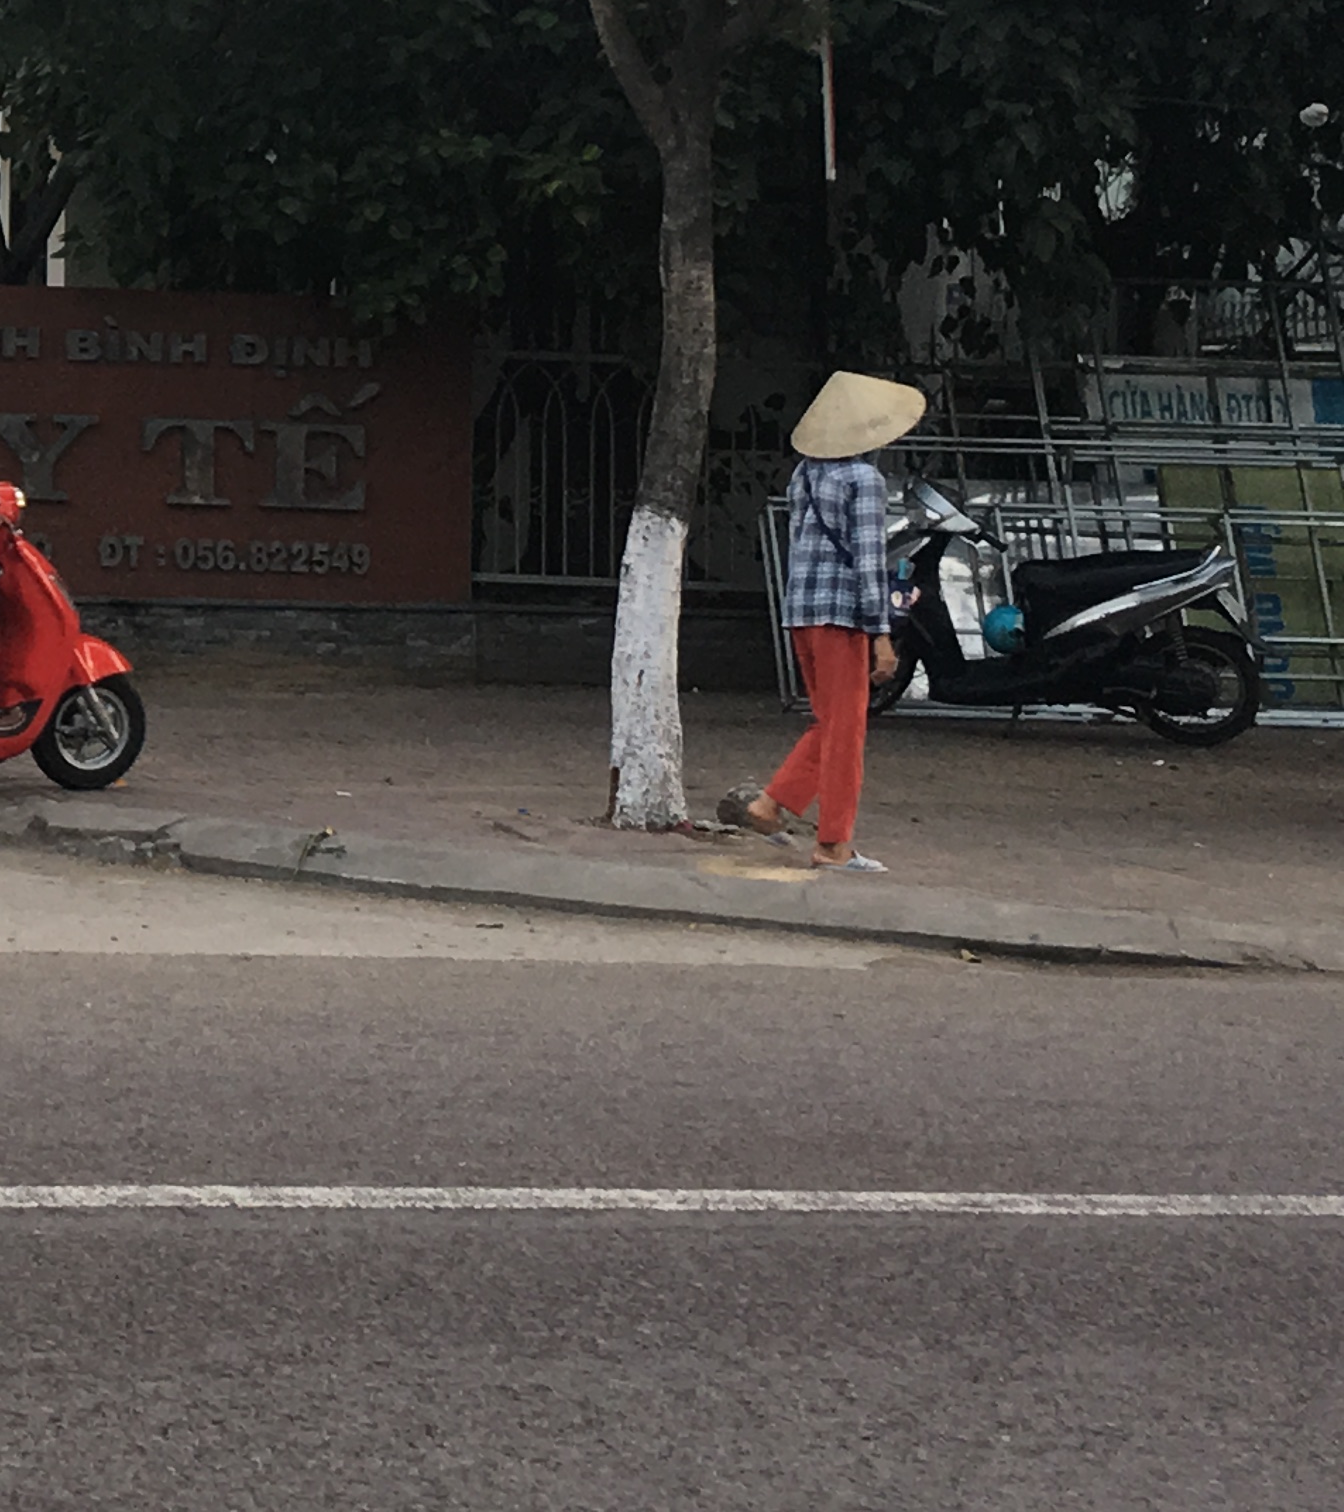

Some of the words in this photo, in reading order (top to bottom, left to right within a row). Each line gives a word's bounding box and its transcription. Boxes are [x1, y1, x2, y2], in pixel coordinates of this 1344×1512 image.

[65, 315, 208, 364] BÌNH
[229, 332, 373, 378] ĐỊNH
[141, 382, 381, 512] TẾ
[97, 534, 144, 567] ĐT
[174, 538, 371, 575] 056.822549
